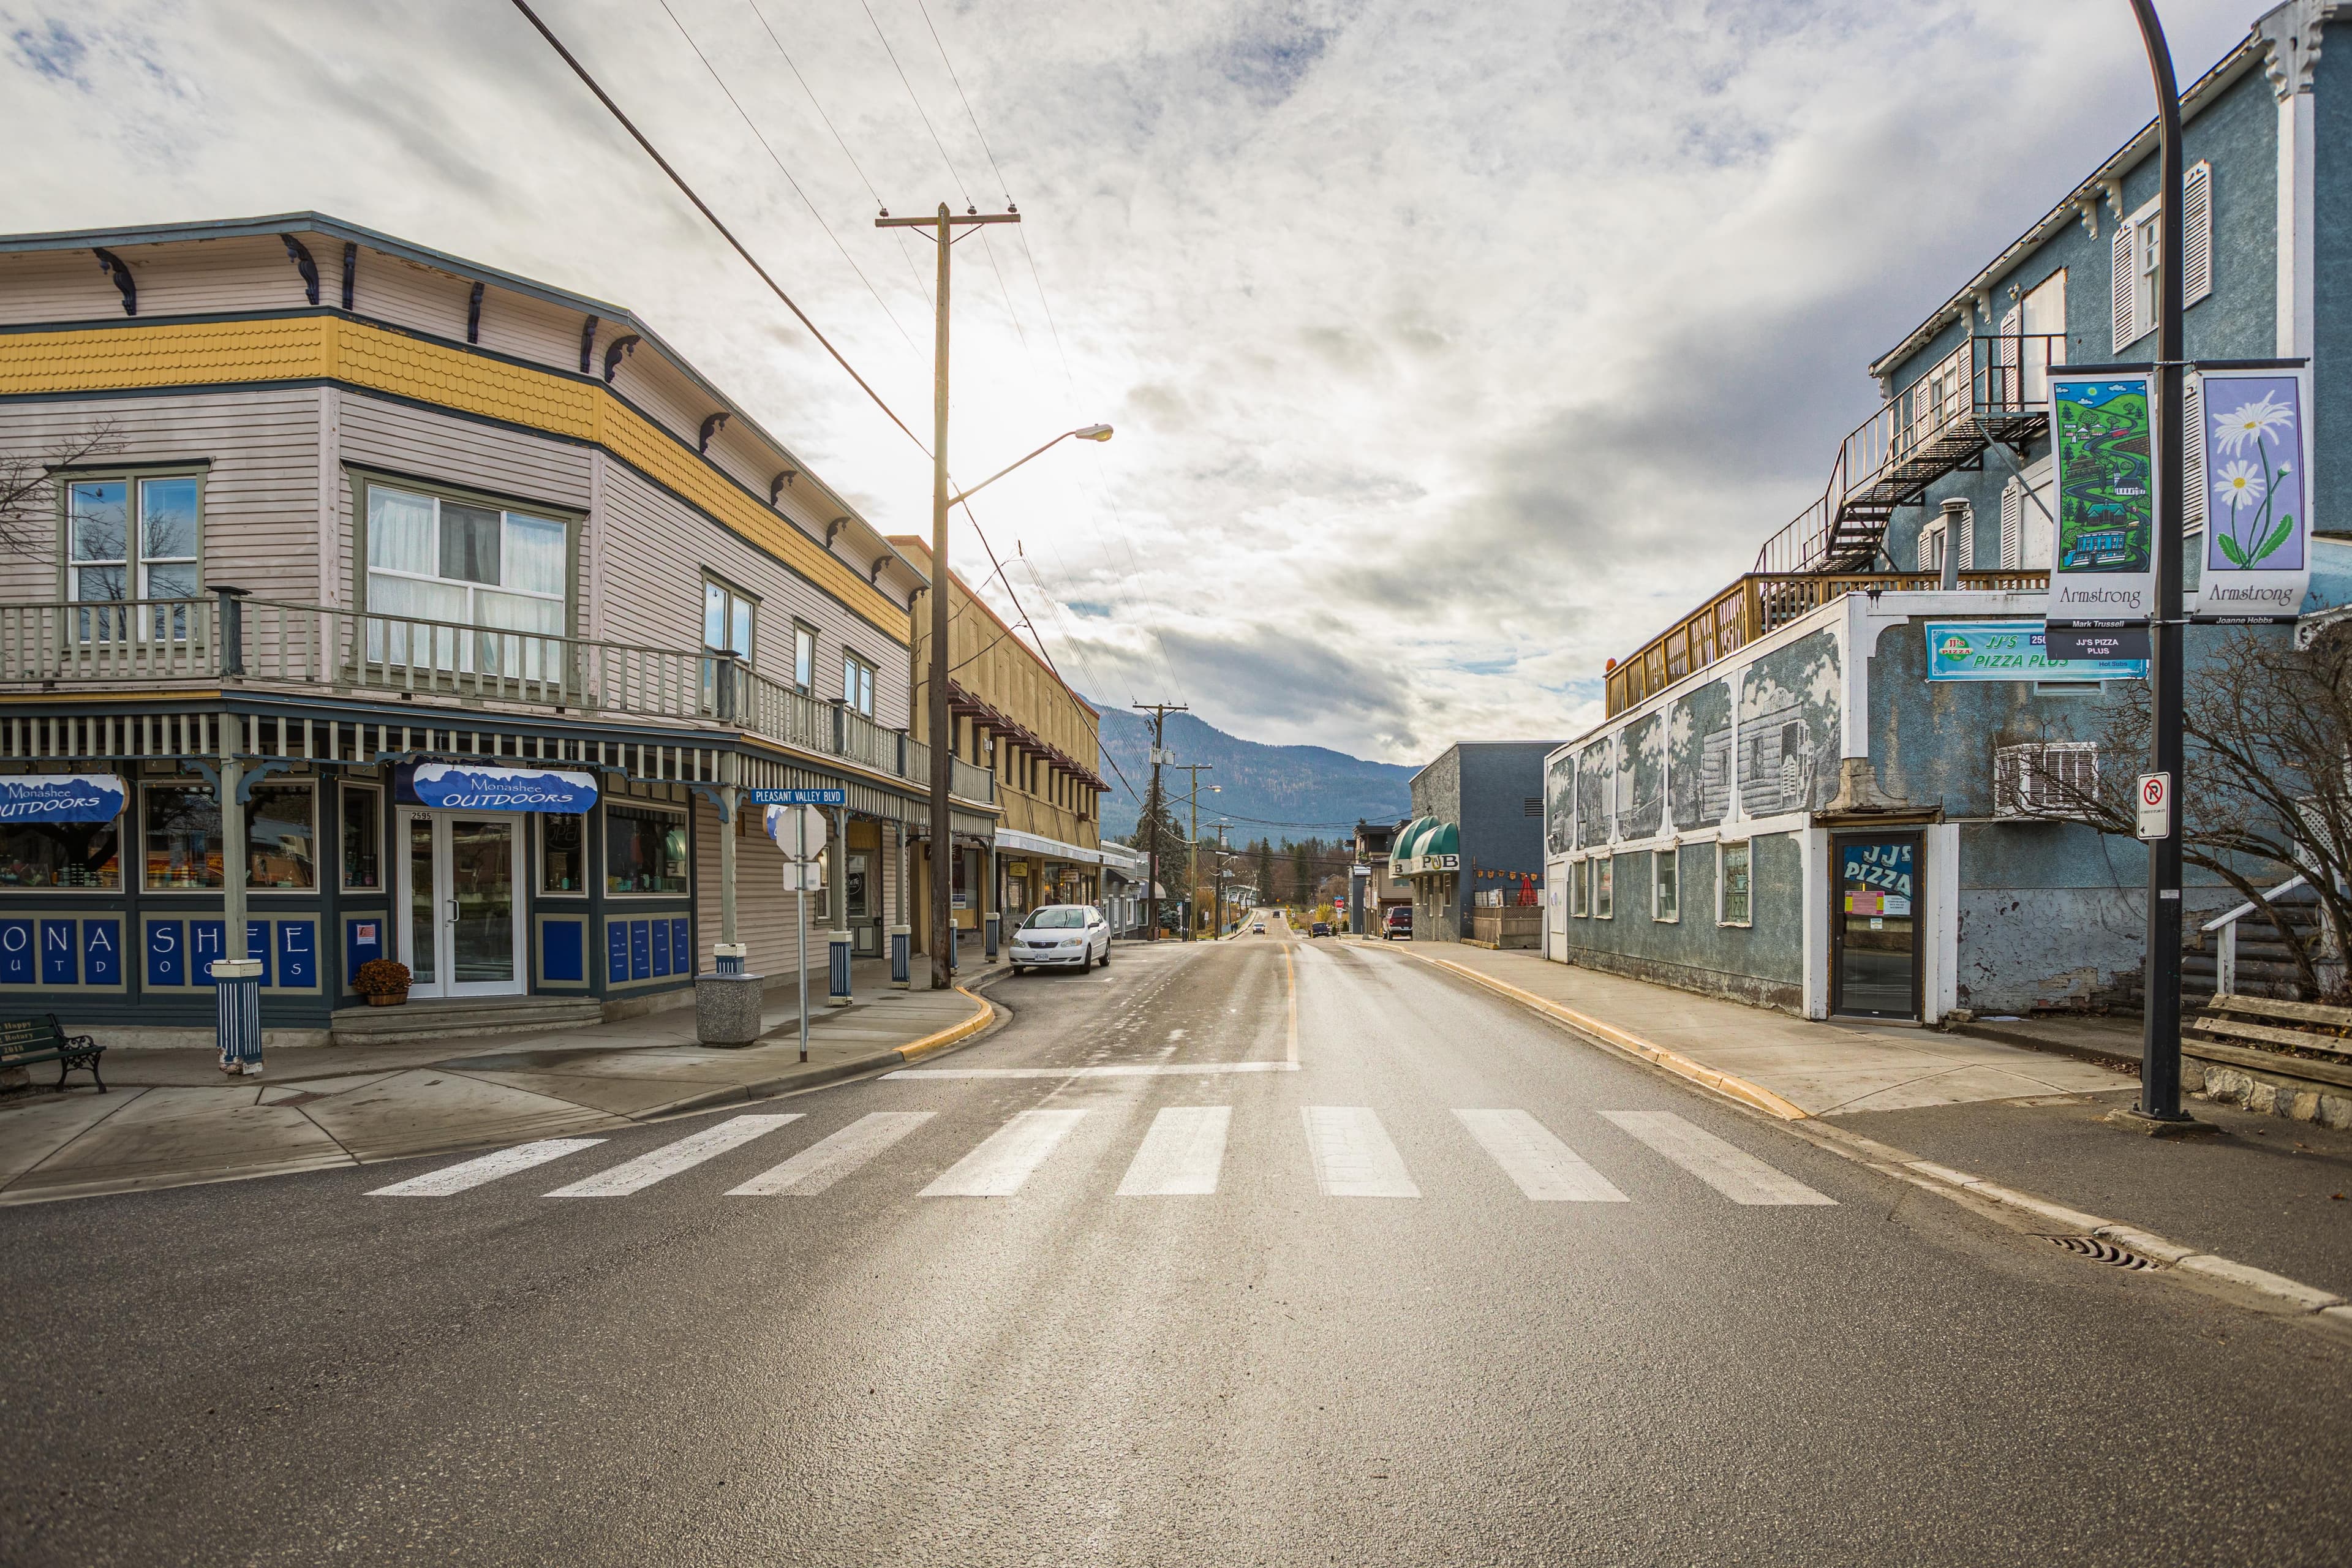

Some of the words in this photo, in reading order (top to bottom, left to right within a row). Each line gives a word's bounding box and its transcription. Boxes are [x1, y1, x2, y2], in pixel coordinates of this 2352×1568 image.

[2060, 586, 2141, 609] Armstrong
[2210, 584, 2293, 606] Armstrong
[1985, 635, 2019, 649] JJ'S
[1972, 654, 2024, 668] PIZZA
[9, 785, 72, 799] Monashee
[471, 778, 541, 793] Monashee
[442, 793, 573, 807] OUTDOORS
[756, 791, 792, 802] PLEASANT
[794, 791, 820, 802] VALLEY
[824, 791, 840, 802] BLVD
[0, 797, 100, 817] UTDOORS
[412, 812, 431, 820] 2595
[1422, 855, 1458, 870] PUB
[1844, 861, 1912, 897] PIZZA
